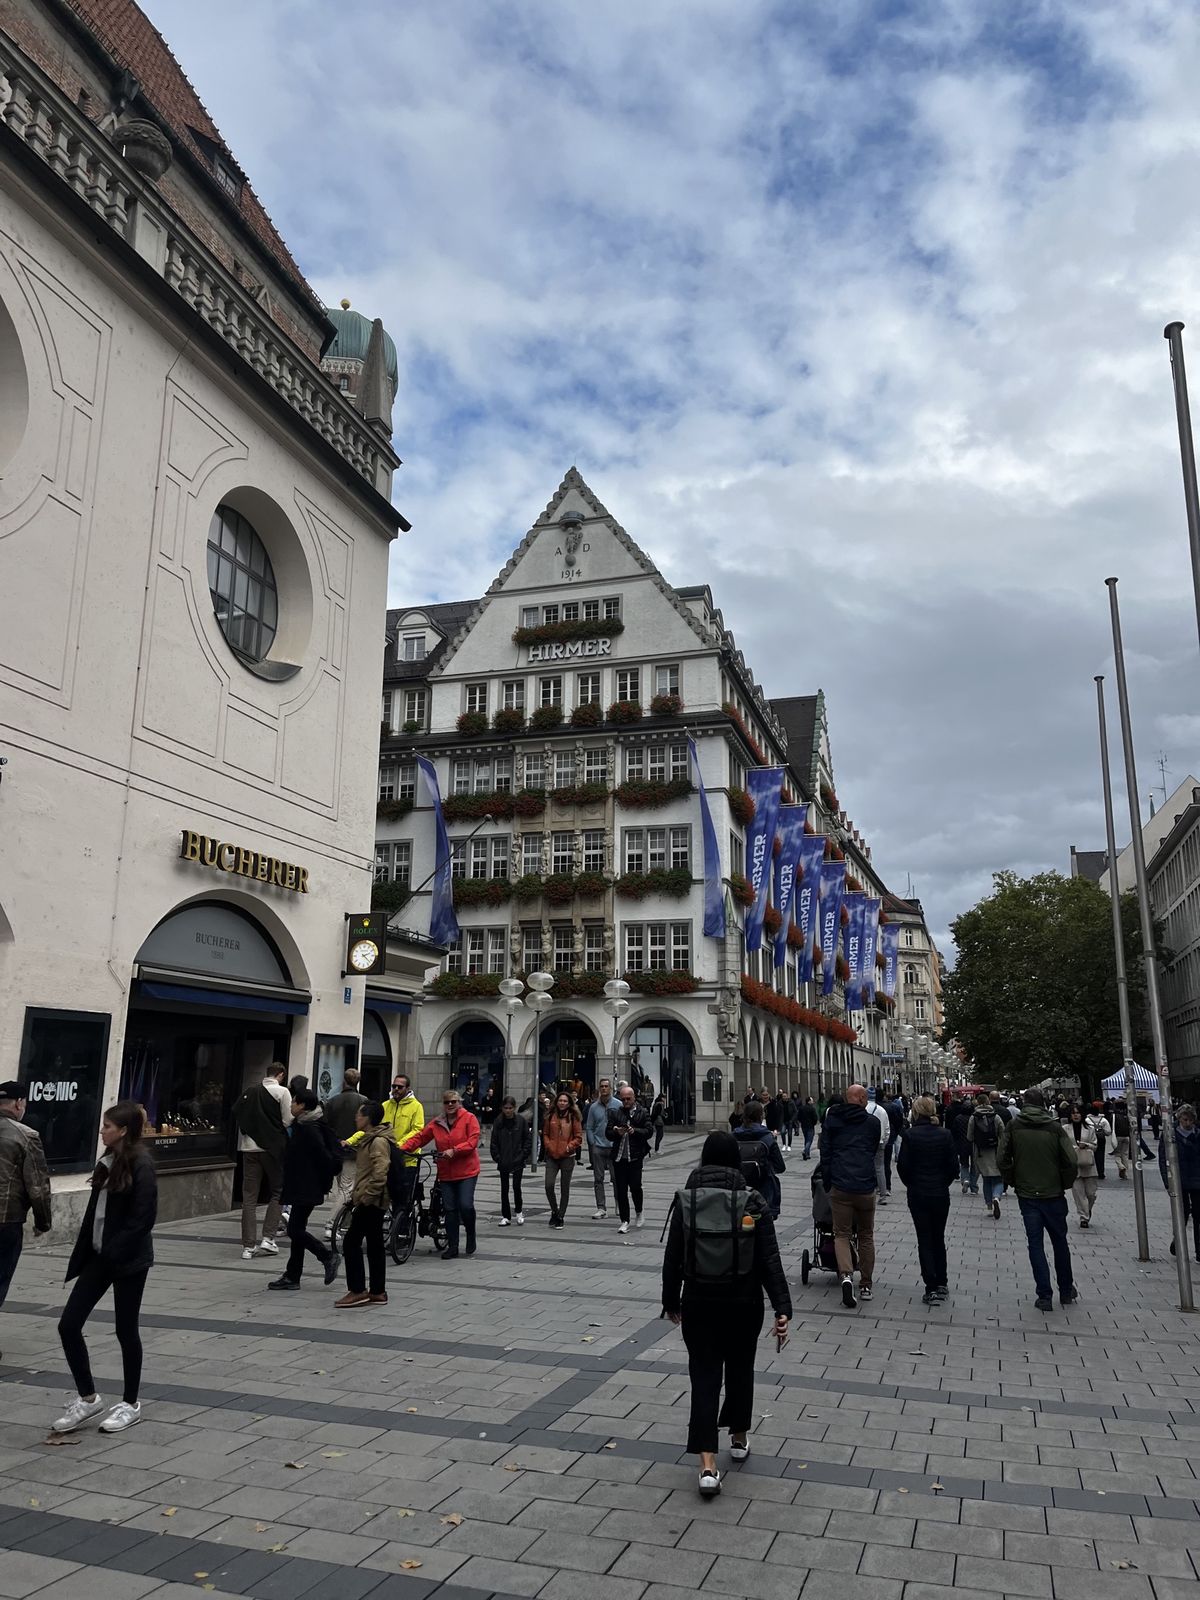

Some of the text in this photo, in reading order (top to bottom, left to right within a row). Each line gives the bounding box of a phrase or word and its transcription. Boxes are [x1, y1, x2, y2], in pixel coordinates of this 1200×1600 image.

[554, 543, 591, 556] A D
[561, 569, 583, 579] 1914
[527, 637, 612, 662] HIRMER
[179, 829, 310, 894] BUCHERER
[195, 931, 240, 951] BUCHERER
[353, 927, 378, 936] ROLEX
[823, 911, 836, 961] HIRMER
[848, 936, 859, 980] HIRMER
